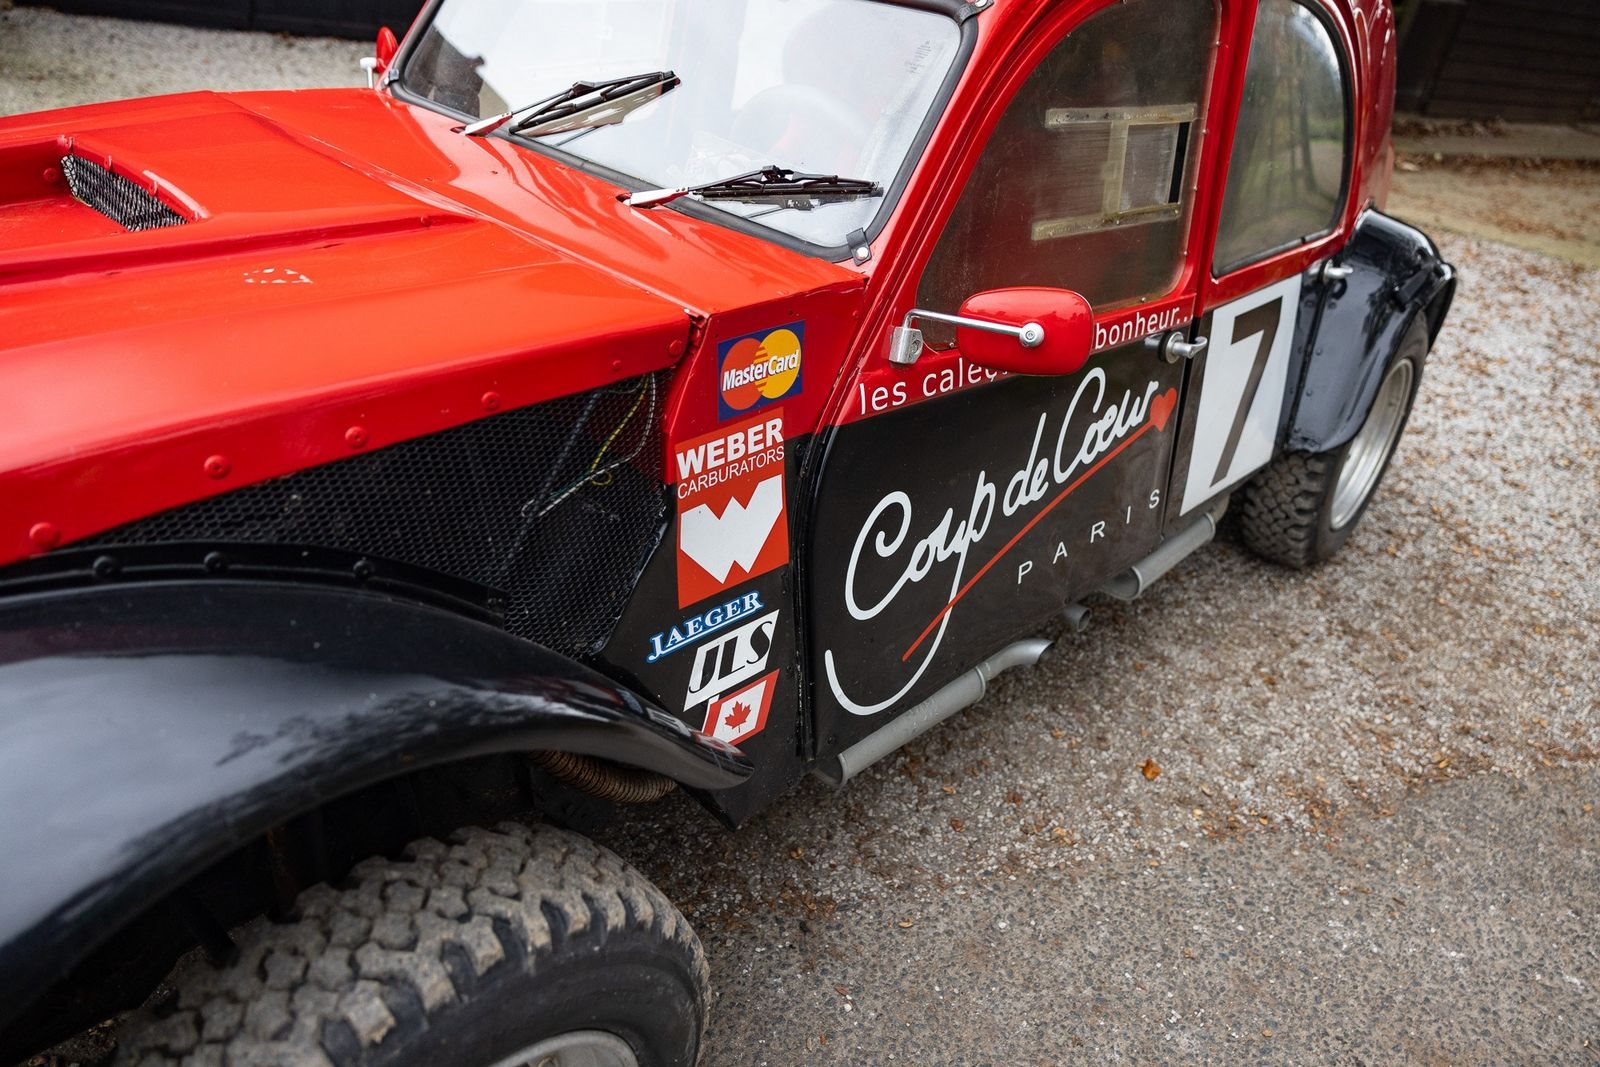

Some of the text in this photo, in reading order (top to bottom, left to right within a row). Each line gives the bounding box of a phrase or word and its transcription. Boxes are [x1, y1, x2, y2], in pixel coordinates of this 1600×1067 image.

[721, 349, 799, 392] MasterCard
[858, 382, 907, 415] les
[922, 357, 1008, 397] caleç
[1209, 295, 1284, 488] 7
[676, 417, 784, 480] WEBER
[677, 445, 785, 500] CARBURATORS
[825, 470, 996, 716] Coup
[1002, 412, 1049, 518] de
[1018, 488, 1161, 585] PARIS
[647, 591, 764, 662] JAEGER
[688, 620, 773, 694] JLS
